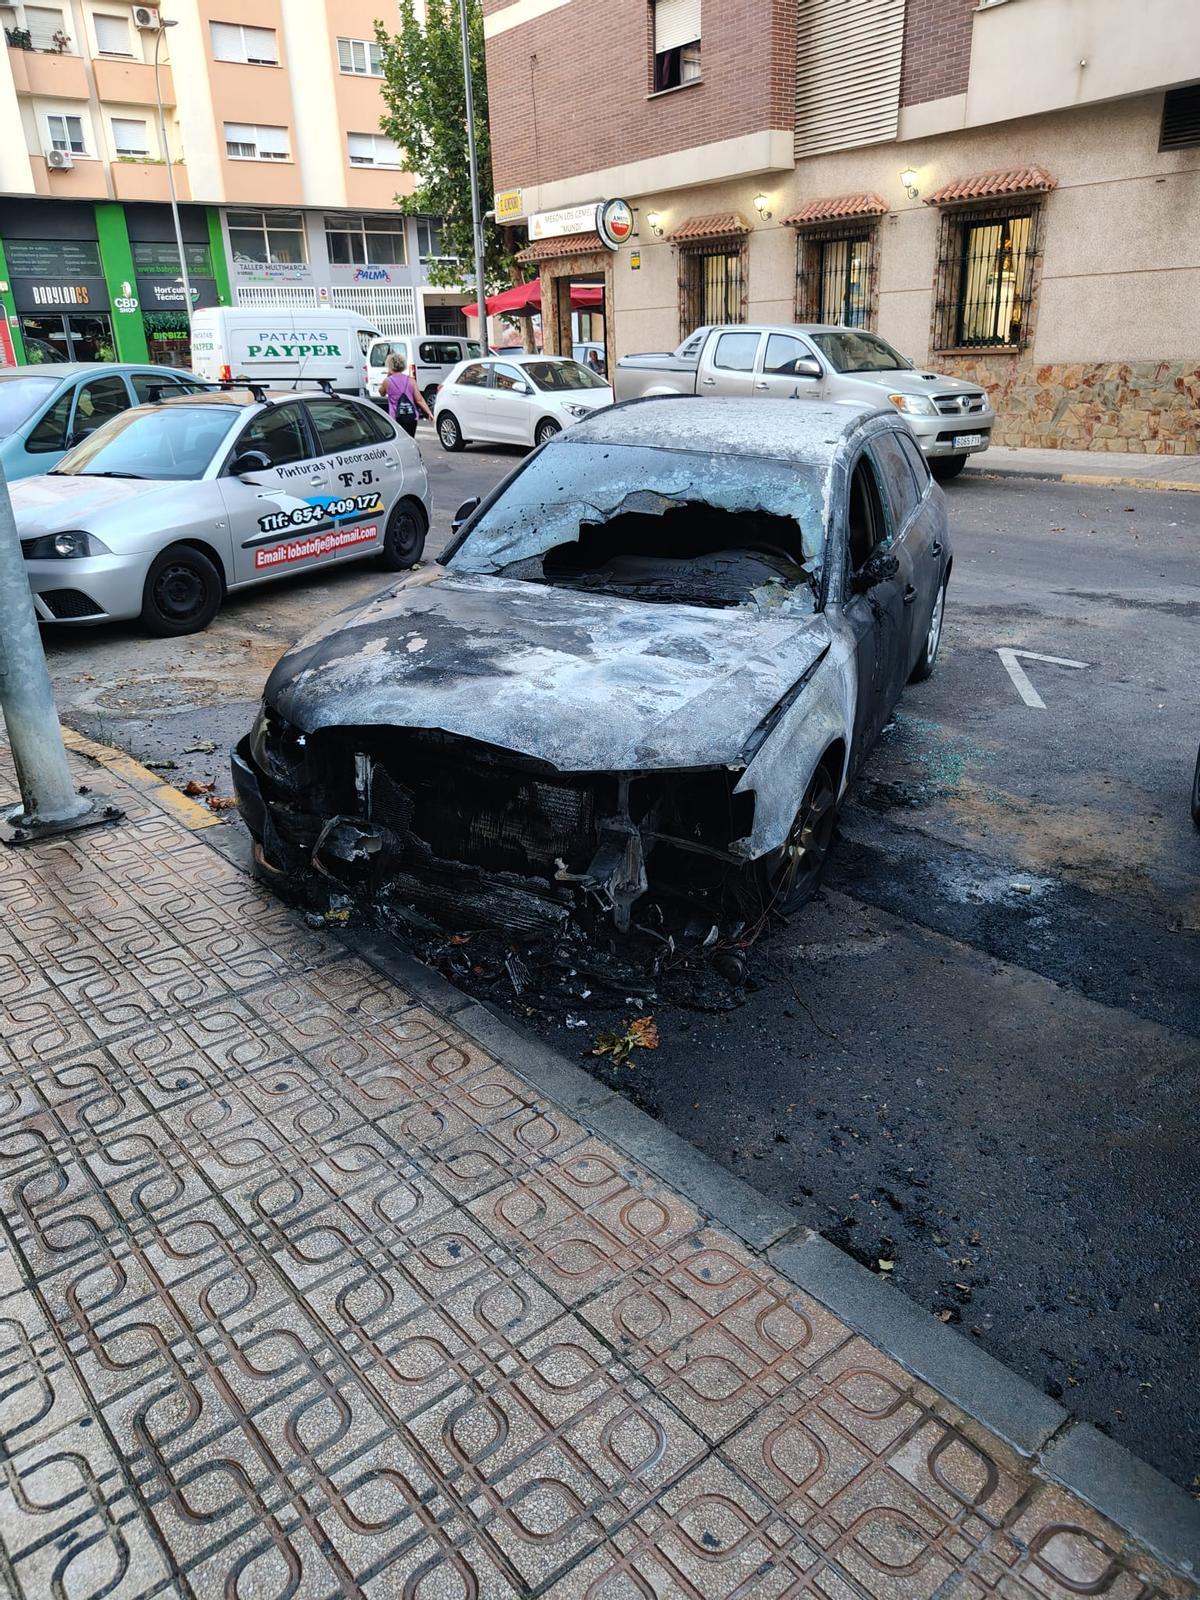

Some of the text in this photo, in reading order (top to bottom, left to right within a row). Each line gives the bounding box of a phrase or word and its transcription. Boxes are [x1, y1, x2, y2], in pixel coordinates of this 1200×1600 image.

[357, 270, 388, 280] PALMA
[114, 298, 138, 308] CBD
[259, 332, 328, 341] PATATAS
[248, 345, 342, 357] PAYPER
[276, 448, 388, 479] Pinturas y Decoración
[262, 494, 379, 530] Tlf: 654 409 177
[257, 530, 376, 566] Email: lobatofje@hotmail.com
